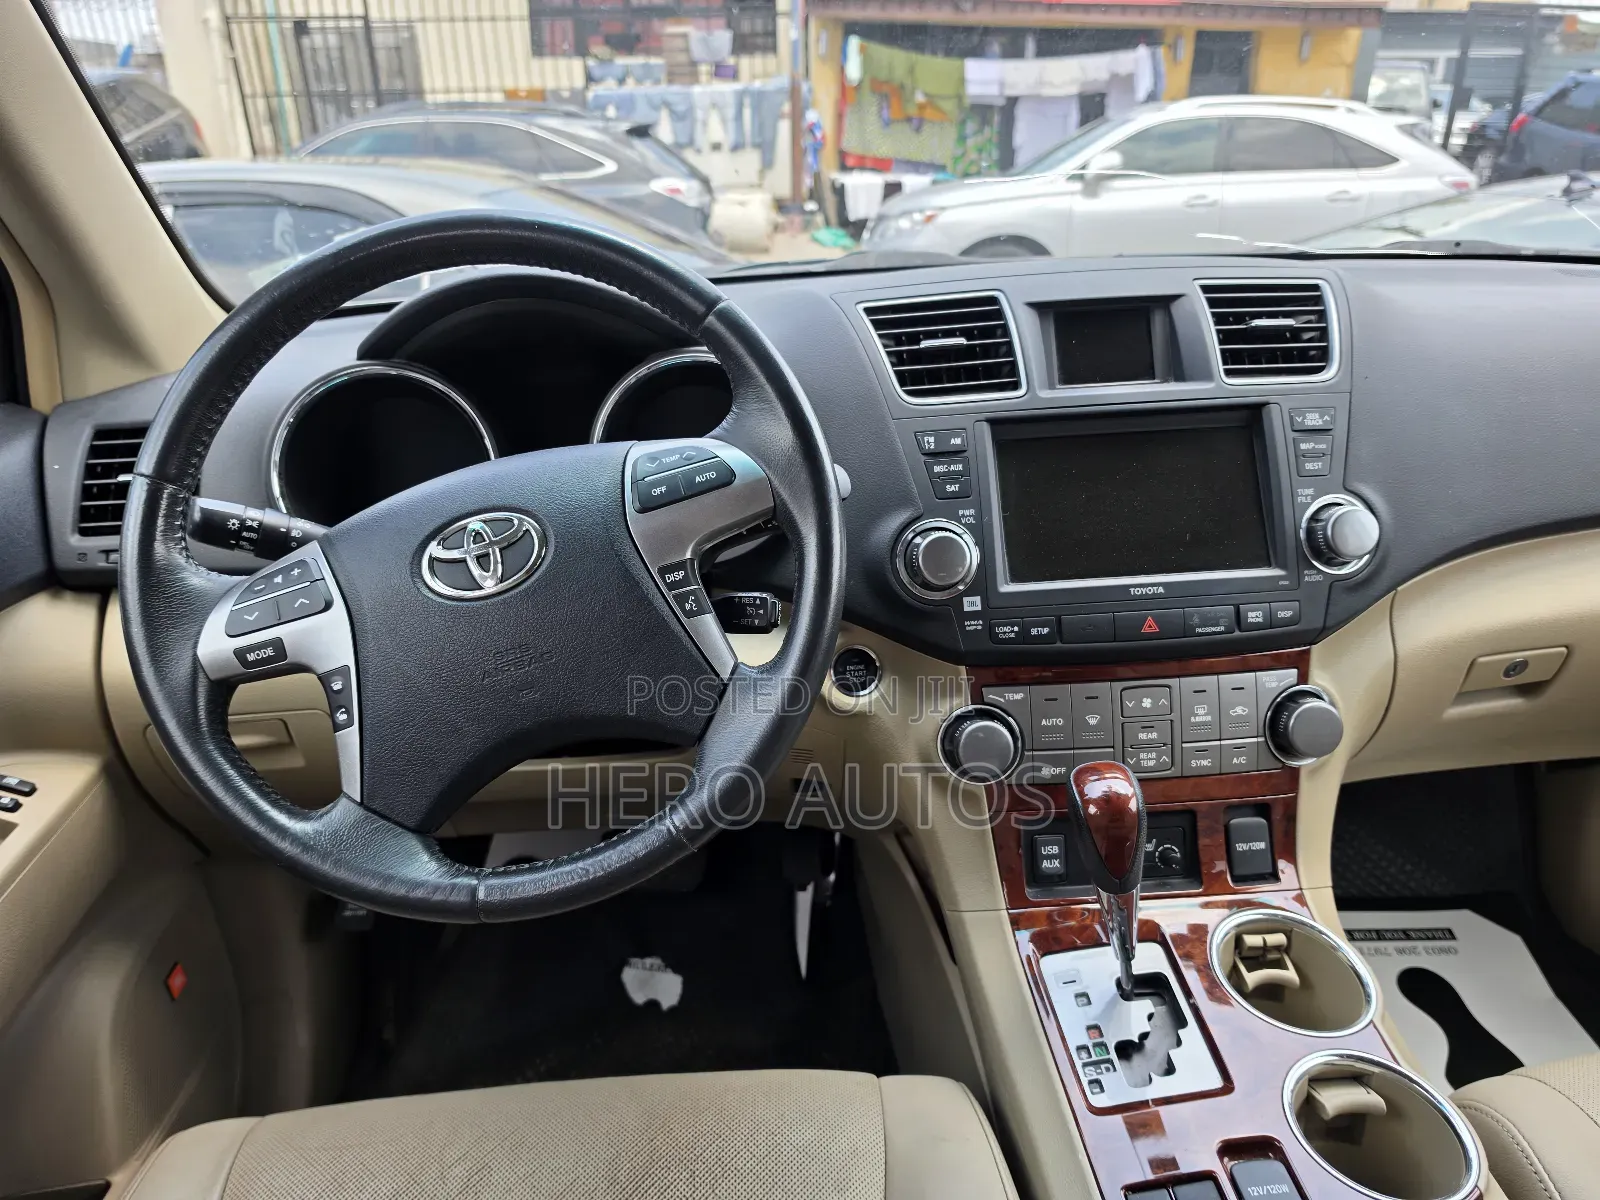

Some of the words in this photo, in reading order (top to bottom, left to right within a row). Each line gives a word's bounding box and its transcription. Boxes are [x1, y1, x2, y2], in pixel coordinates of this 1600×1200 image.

[662, 454, 681, 464] TEMP
[695, 471, 717, 483] AUTO
[651, 485, 667, 496] OFF
[945, 484, 960, 492] SAT
[241, 531, 258, 540] AUTO
[665, 571, 685, 583] DISP
[1129, 586, 1165, 596] TOYOTA
[1030, 627, 1050, 635] SETUP
[246, 647, 276, 663] MODE
[1041, 718, 1064, 726] AUTO
[1138, 732, 1158, 740] REAR
[1140, 759, 1156, 767] TEMP
[1190, 758, 1212, 767] SYNC
[1232, 756, 1247, 764] A/C
[1051, 767, 1067, 775] OFF
[1041, 845, 1059, 854] USB
[1235, 842, 1266, 851] 12V/120W
[1041, 859, 1060, 868] AUX
[1095, 1046, 1108, 1058] N
[1247, 1183, 1290, 1196] 12V/120W
